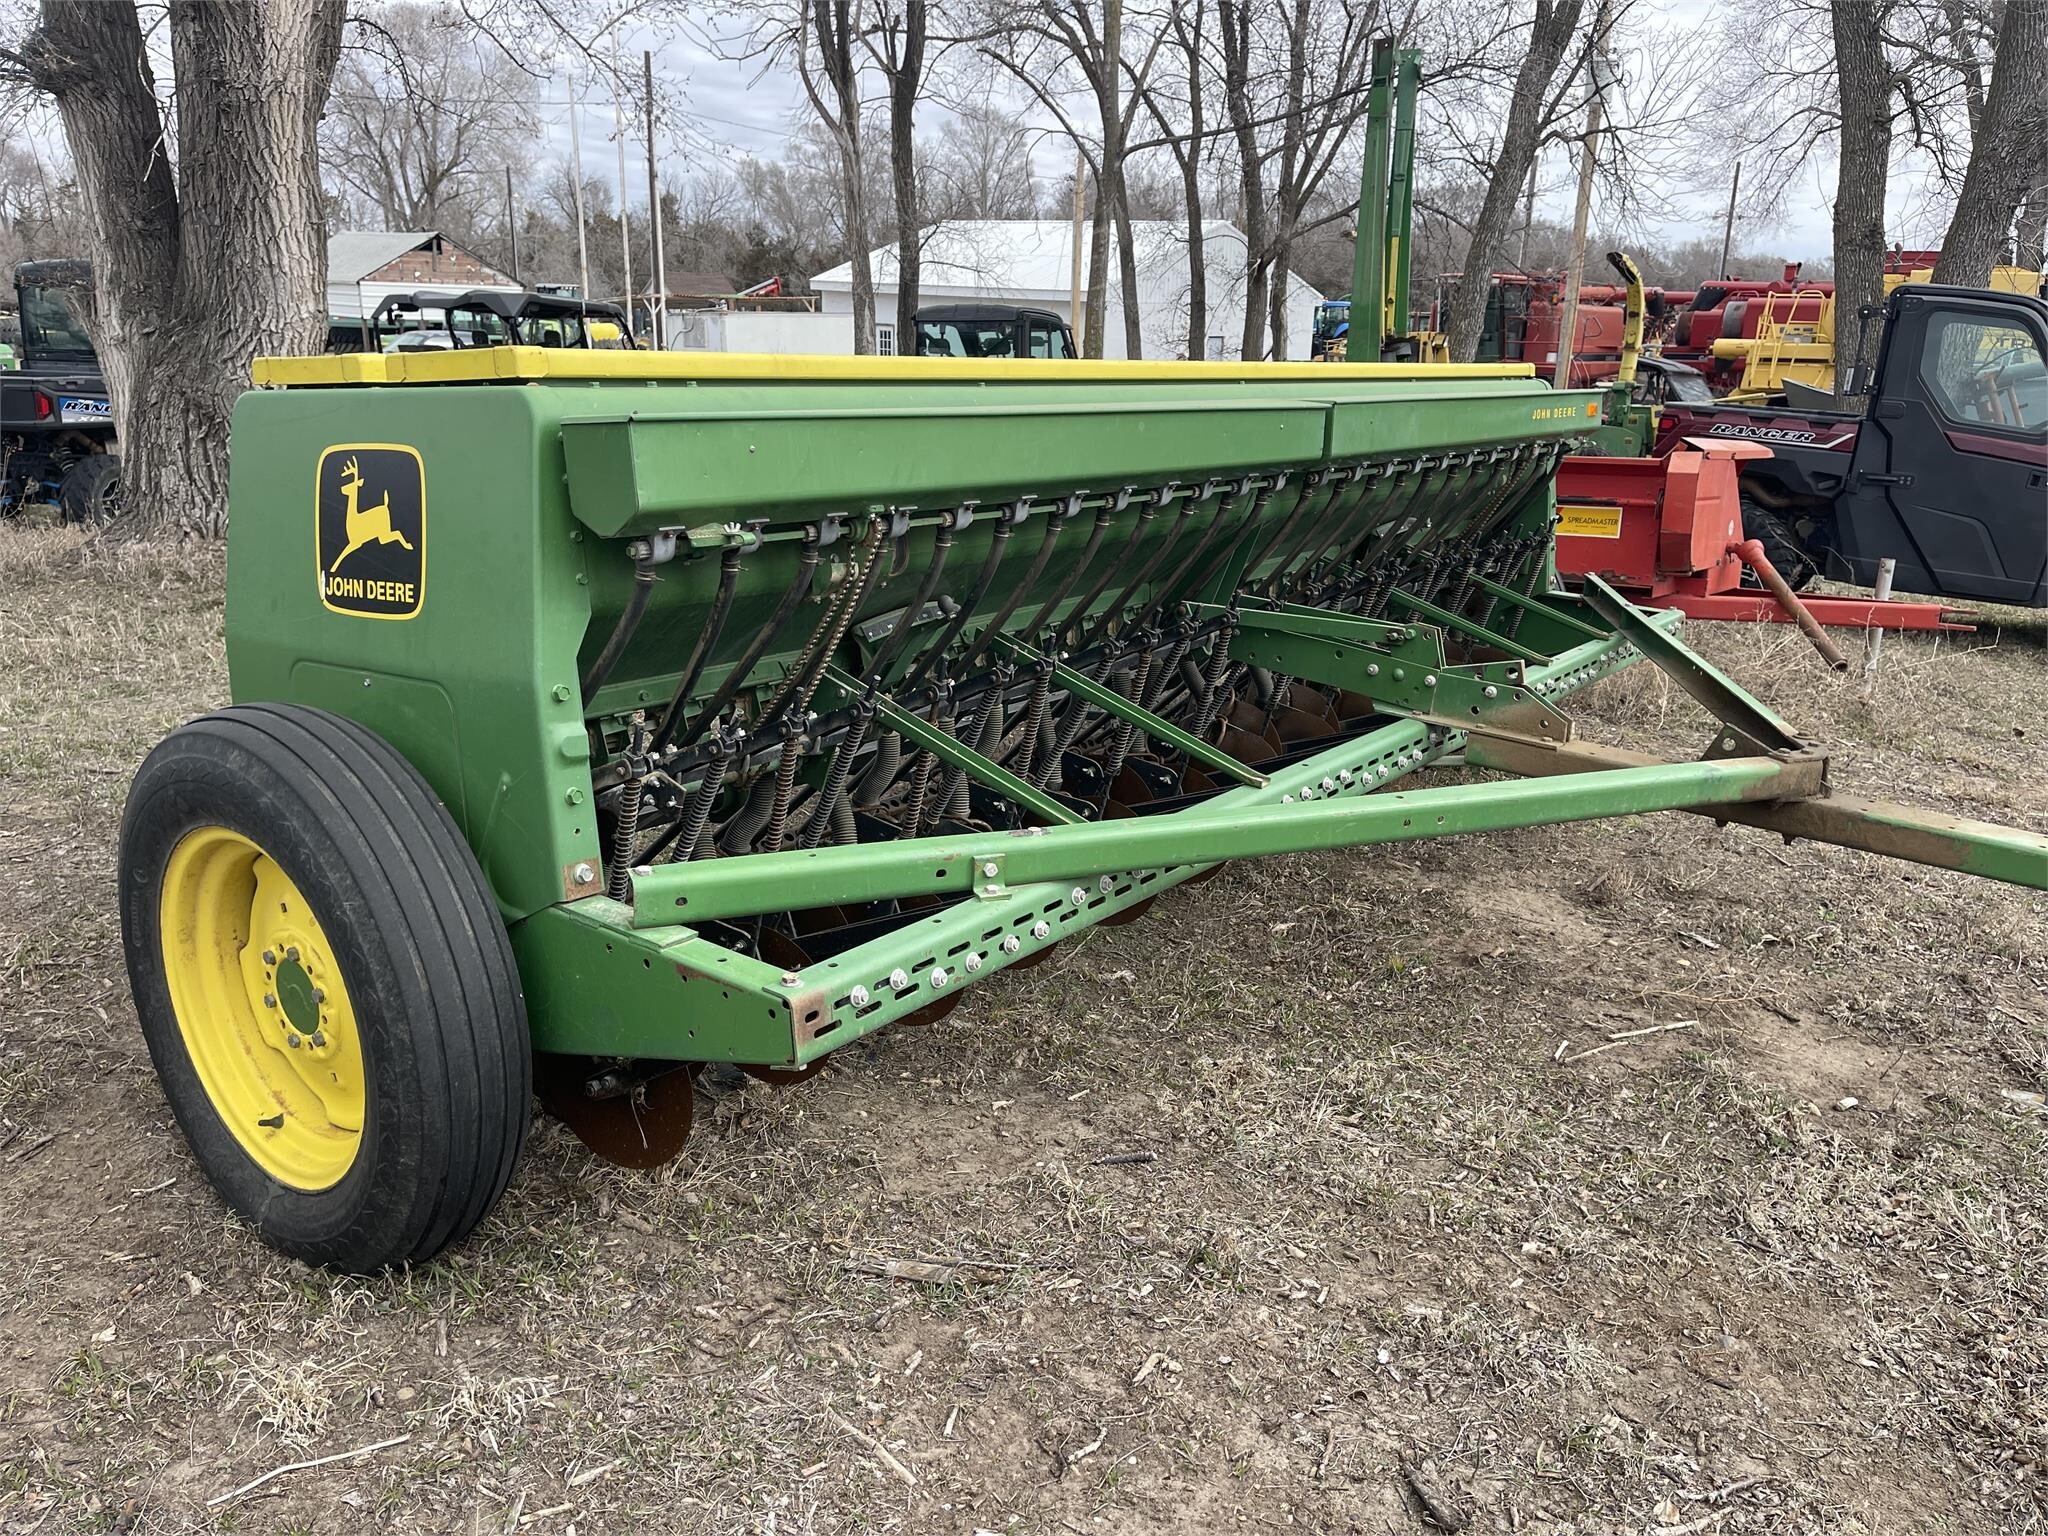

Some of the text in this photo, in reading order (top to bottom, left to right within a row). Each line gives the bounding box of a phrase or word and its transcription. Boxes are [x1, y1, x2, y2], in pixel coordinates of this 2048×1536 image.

[1532, 407, 1576, 420] JOHN DEERE
[1709, 424, 1816, 442] RANGER
[1567, 516, 1618, 525] SPREADMASTER
[326, 576, 415, 603] JOHN DEERE
